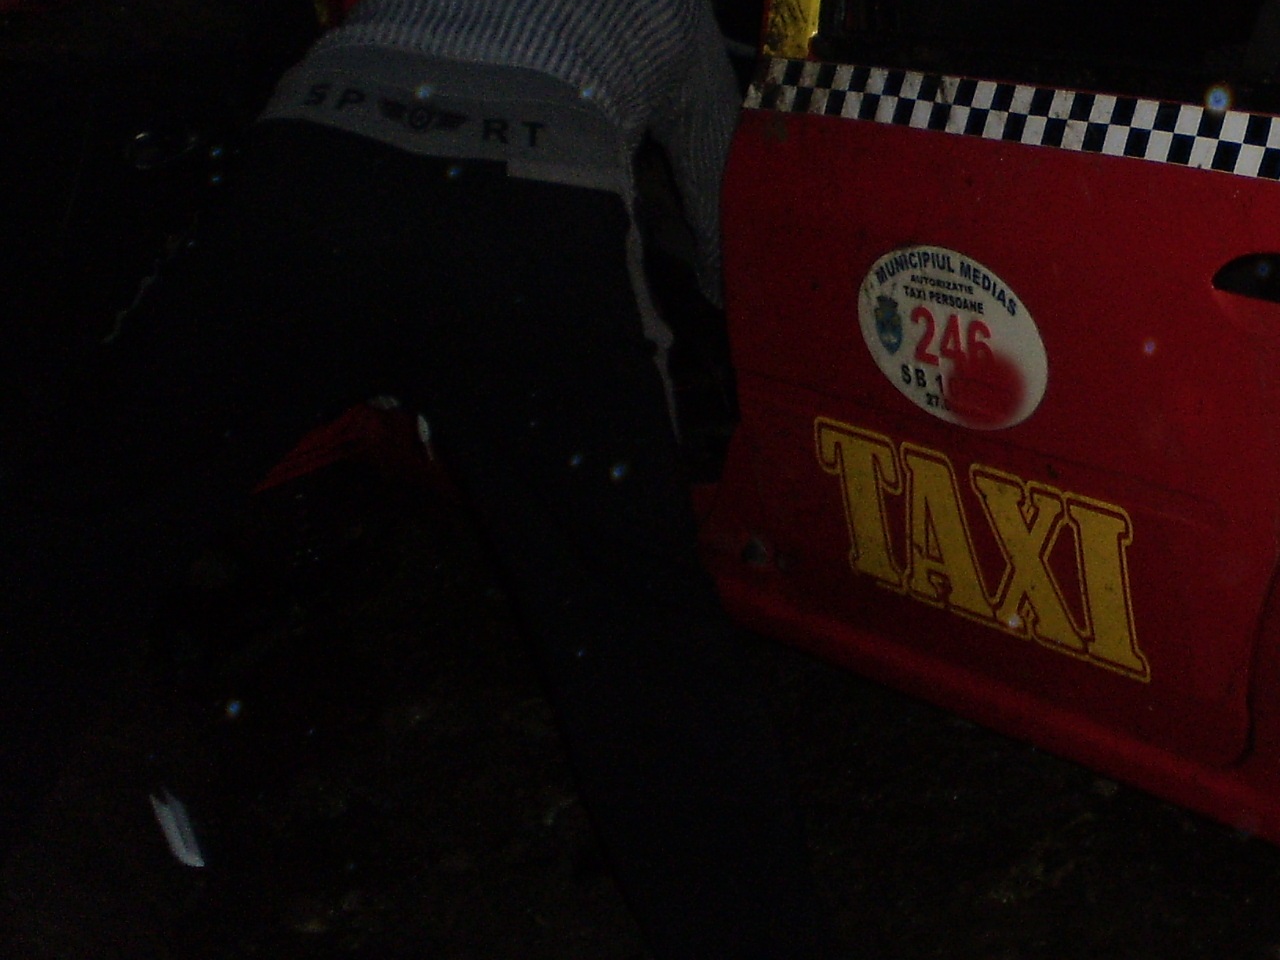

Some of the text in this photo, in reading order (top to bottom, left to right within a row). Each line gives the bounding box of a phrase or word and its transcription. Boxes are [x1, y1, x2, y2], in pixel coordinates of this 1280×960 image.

[304, 84, 545, 147] SPORT
[874, 251, 1018, 316] MUNICIPIUL MEDIAS
[903, 285, 985, 315] TAXI PERSOANE
[910, 274, 975, 295] AUTORIZATIE
[910, 304, 995, 368] 246
[814, 416, 1151, 683] TAXI
